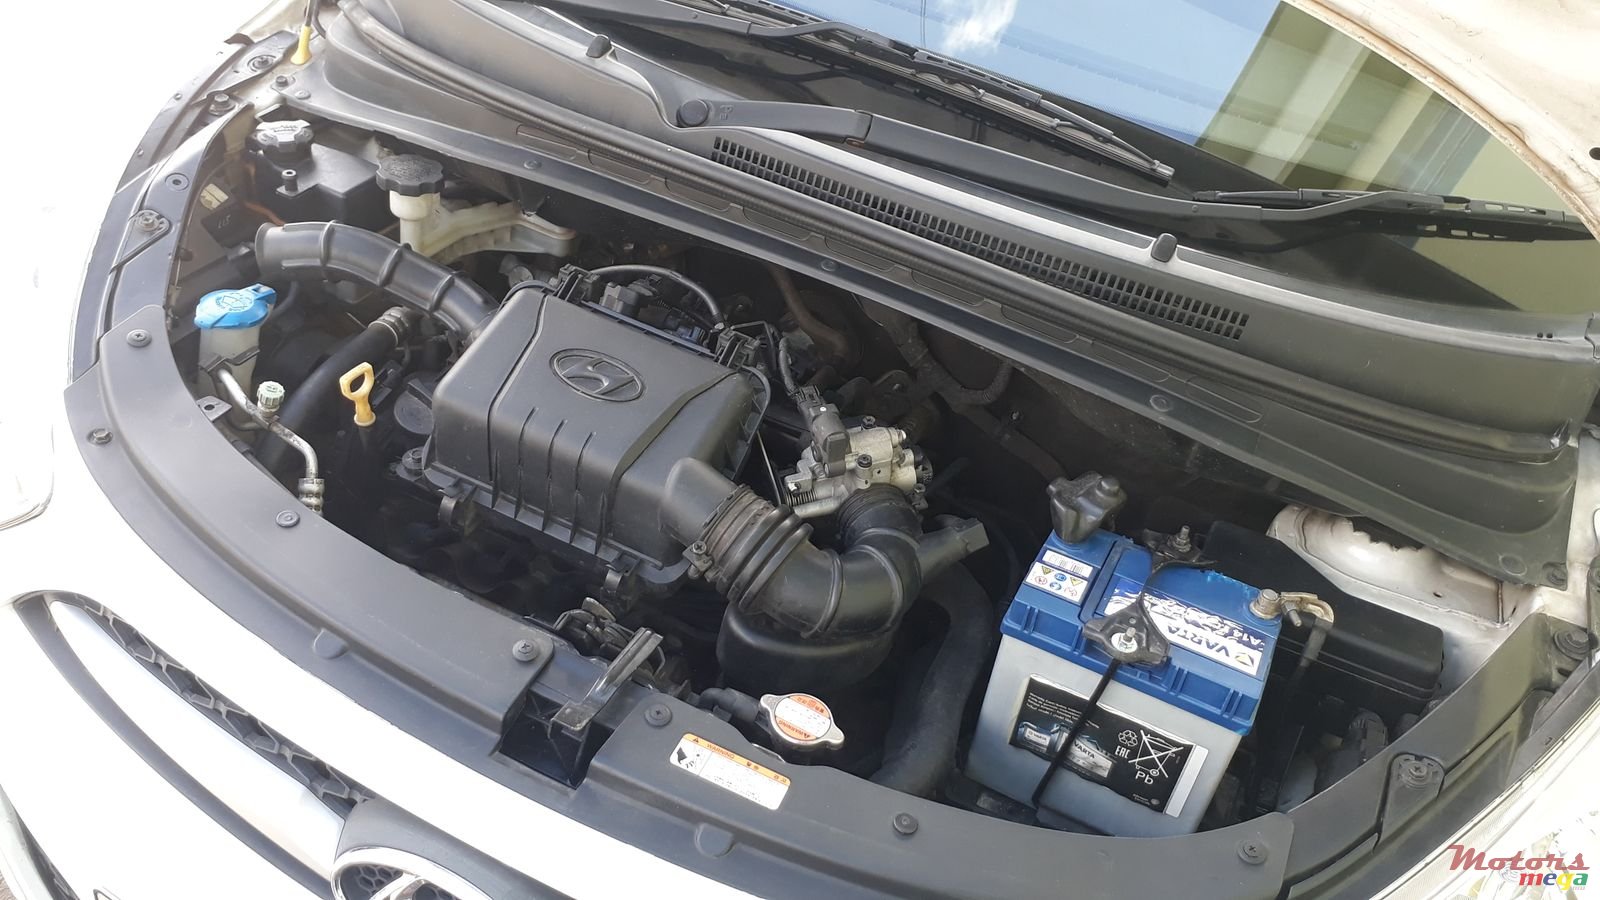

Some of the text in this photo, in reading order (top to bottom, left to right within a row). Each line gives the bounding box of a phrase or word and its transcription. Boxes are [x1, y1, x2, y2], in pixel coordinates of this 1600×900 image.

[1168, 625, 1229, 657] VARTA
[706, 743, 736, 760] WARNING
[1073, 742, 1095, 759] VARTA
[1135, 770, 1154, 785] Pb
